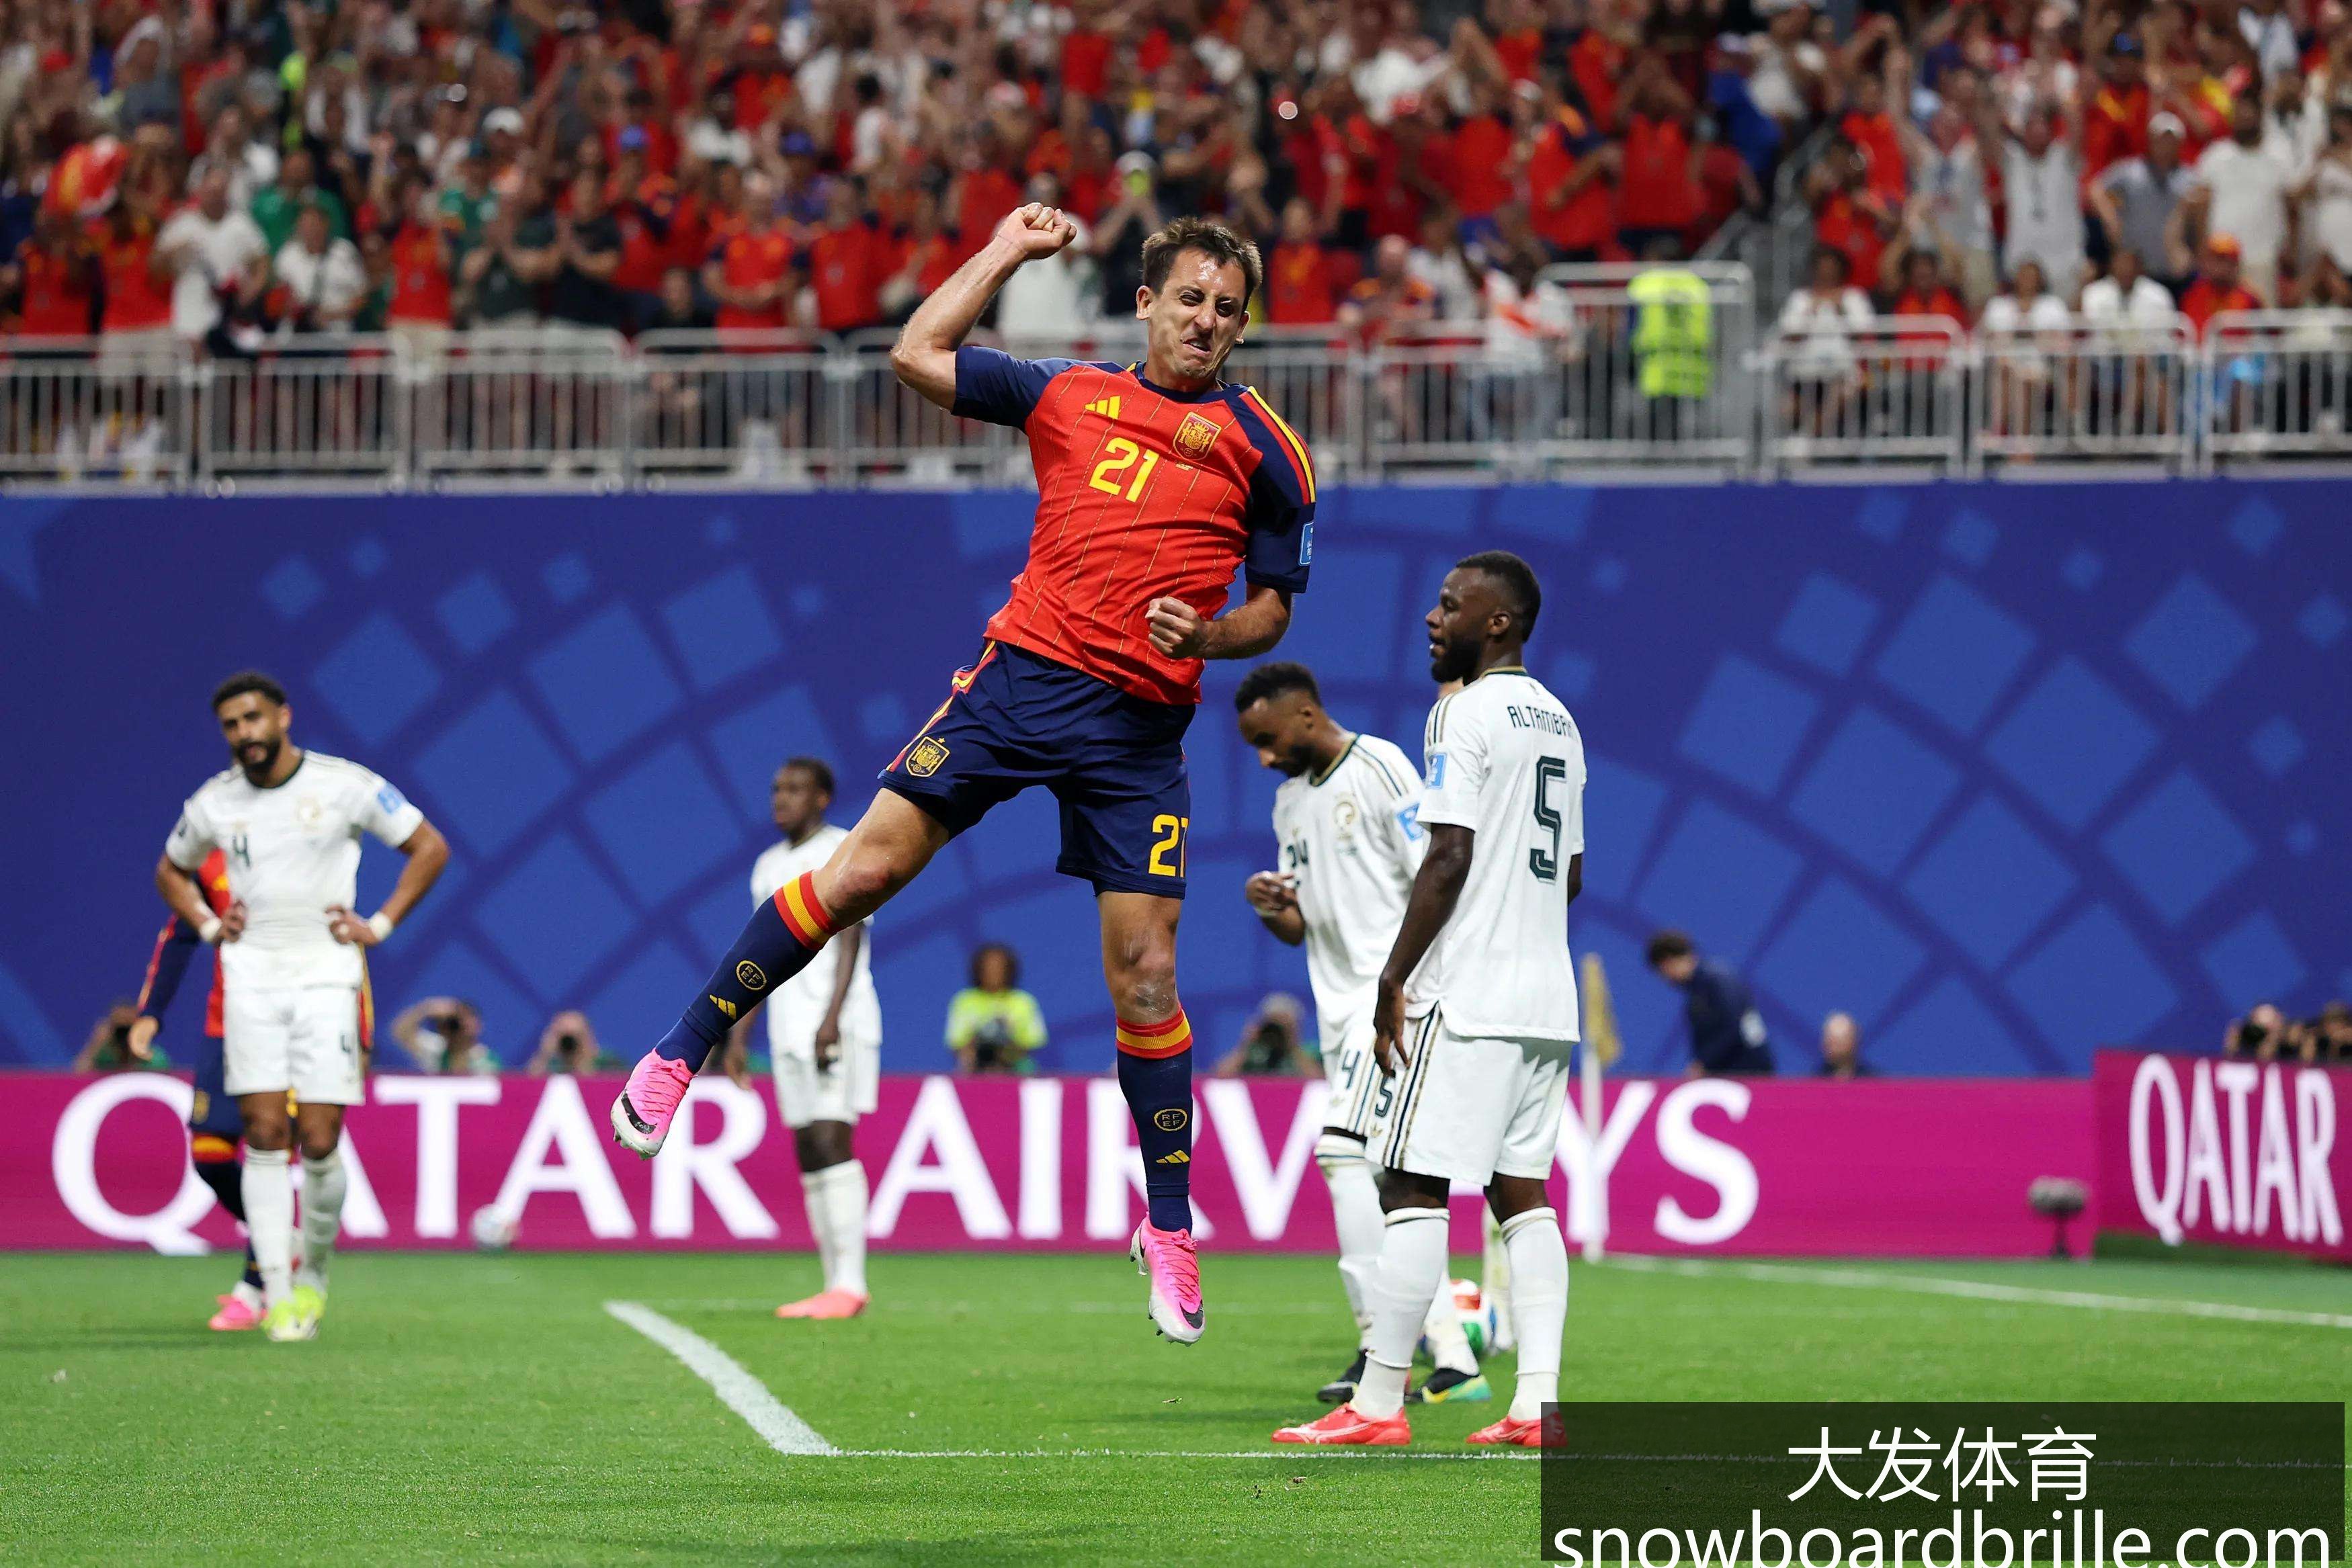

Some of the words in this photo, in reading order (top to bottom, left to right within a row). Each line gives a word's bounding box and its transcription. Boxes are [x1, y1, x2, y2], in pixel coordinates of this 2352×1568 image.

[1088, 437, 1160, 503] 21
[232, 834, 252, 869] 4
[1529, 755, 1566, 885] 5
[1375, 1075, 1393, 1118] 5
[2128, 1053, 2344, 1247] QATAR
